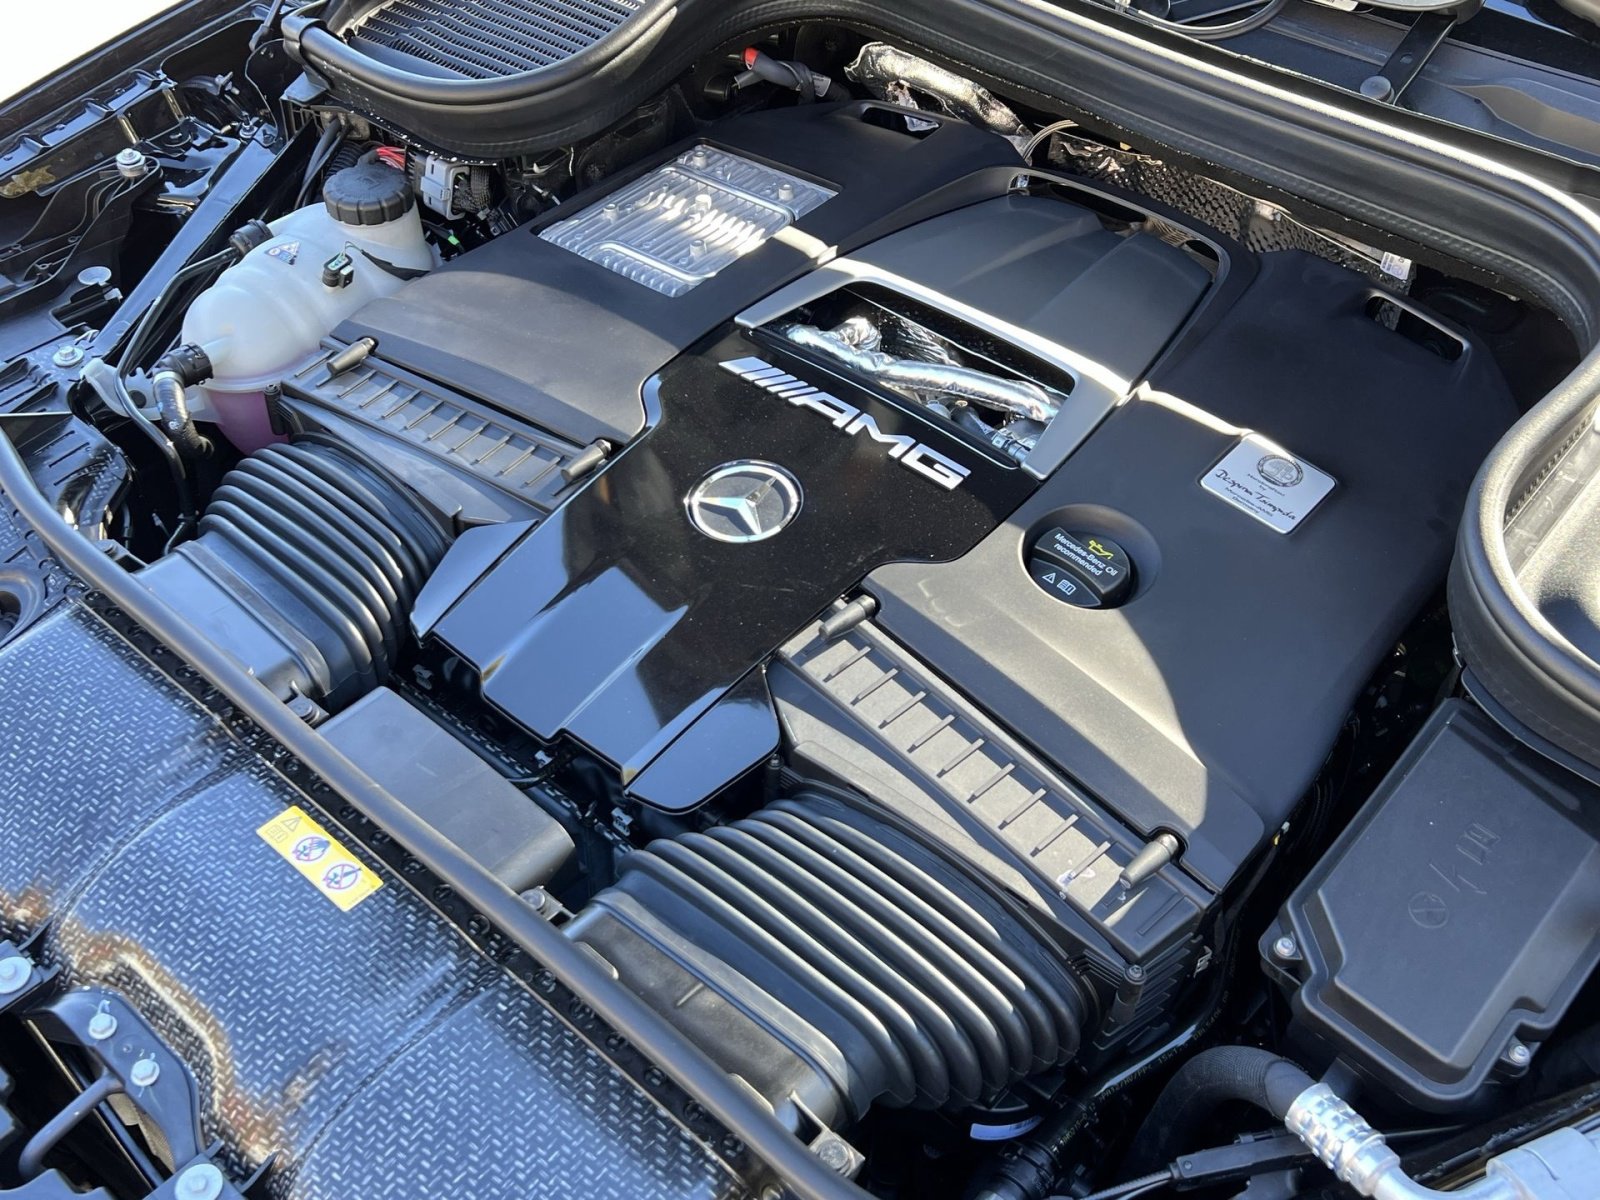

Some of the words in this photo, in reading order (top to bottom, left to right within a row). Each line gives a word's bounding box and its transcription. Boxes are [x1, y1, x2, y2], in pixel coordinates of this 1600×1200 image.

[788, 391, 972, 490] AMG
[1053, 543, 1102, 576] recommended
[1054, 533, 1106, 569] Mercedes-Benz
[1105, 566, 1118, 577] Oil
